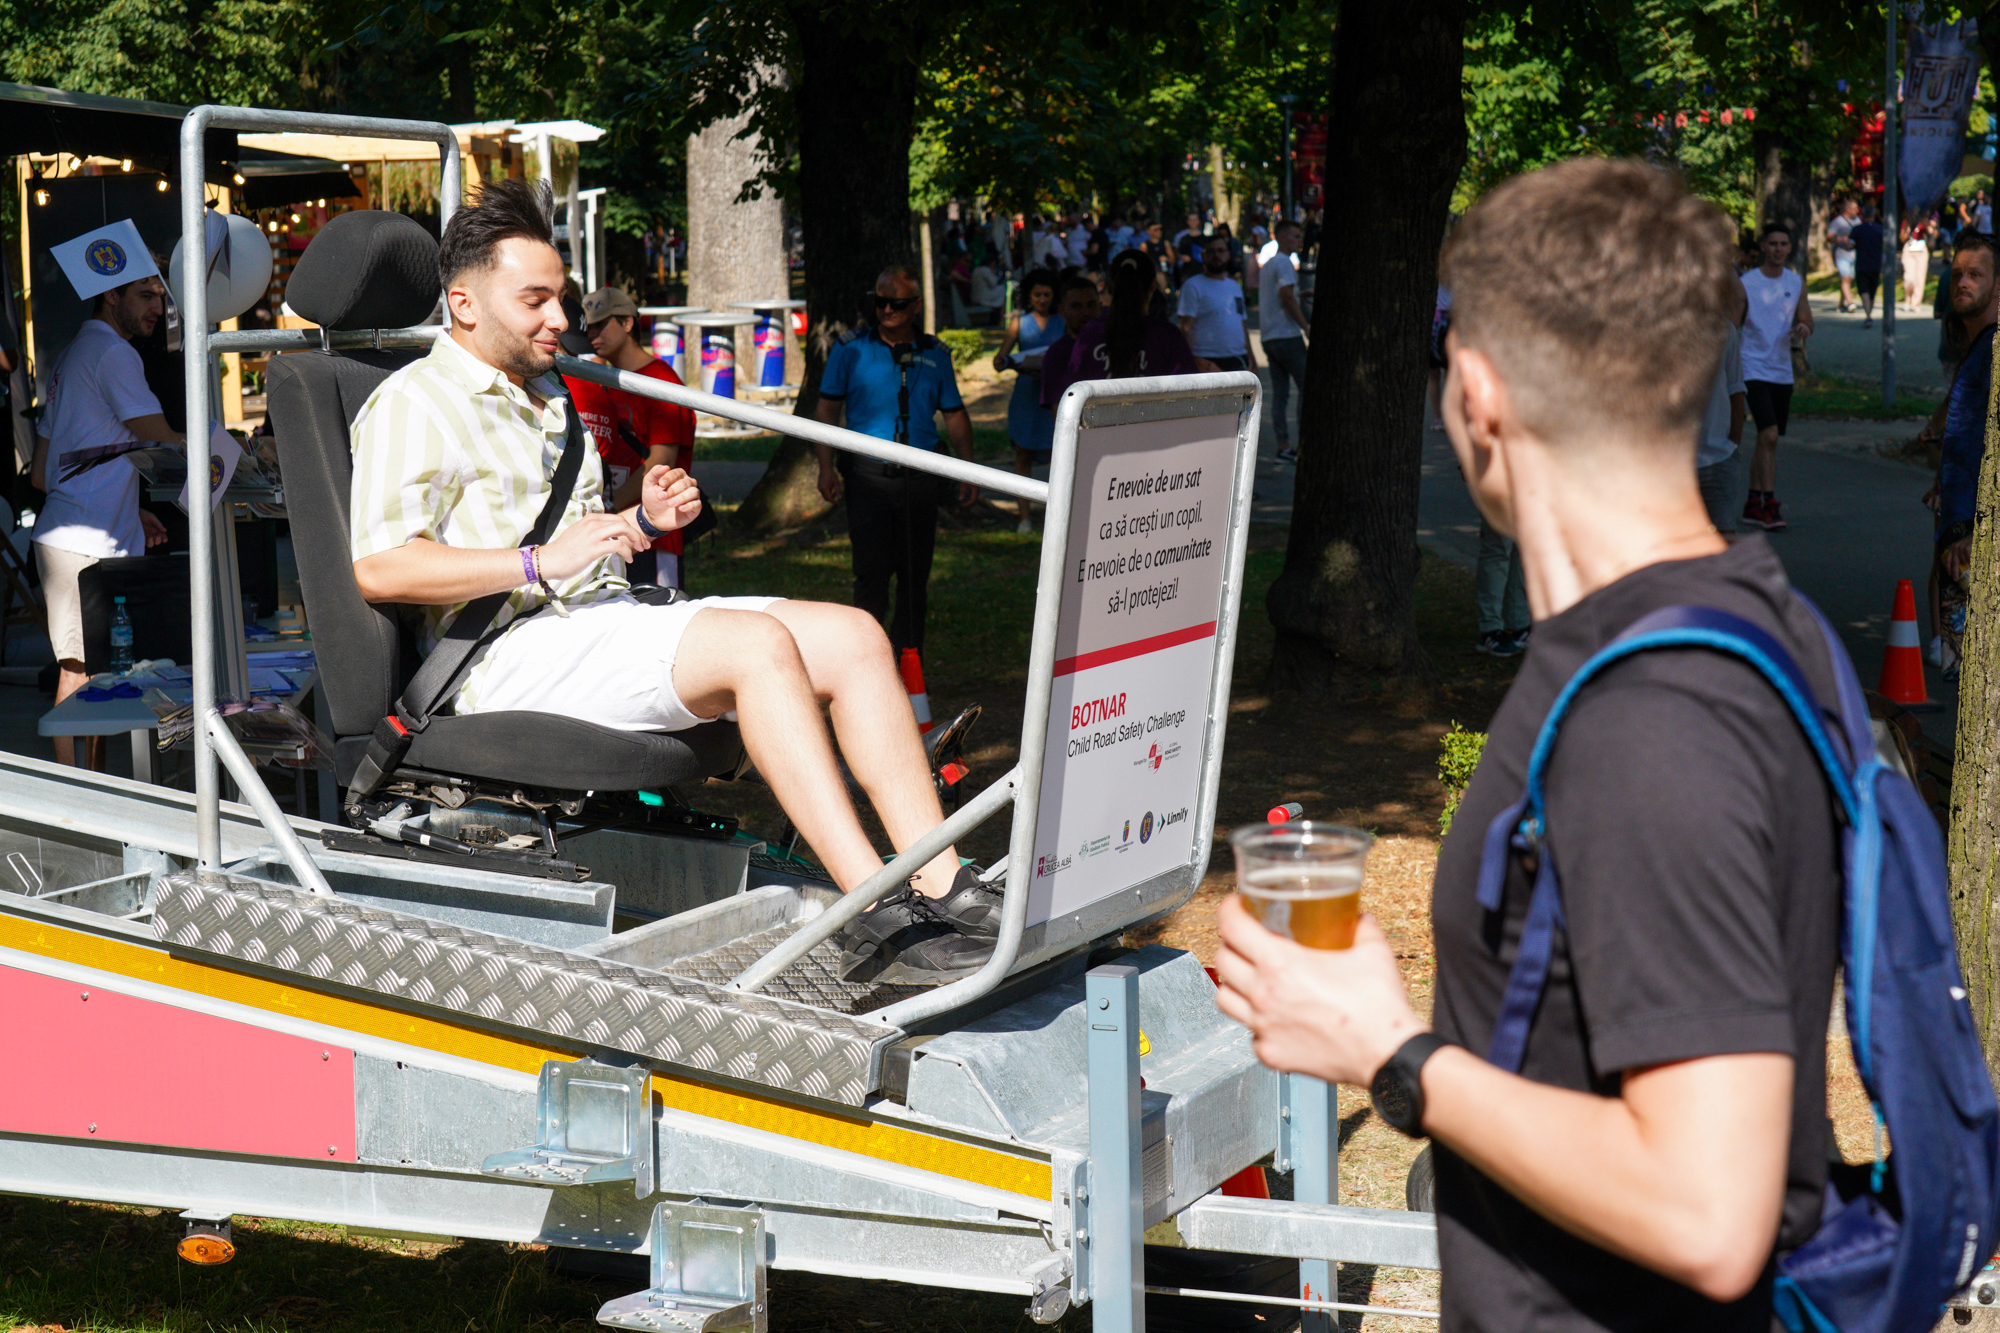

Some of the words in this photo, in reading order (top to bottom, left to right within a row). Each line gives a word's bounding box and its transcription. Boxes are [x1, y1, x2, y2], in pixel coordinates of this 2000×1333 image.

[600, 415, 609, 425] TO
[1108, 477, 1117, 501] E
[1117, 472, 1154, 499] nevoie
[1155, 469, 1168, 493] de
[1170, 472, 1184, 491] un
[1185, 467, 1202, 488] sat
[1100, 521, 1112, 540] ca
[1115, 513, 1127, 538] să
[1129, 508, 1159, 538] crești
[1161, 511, 1174, 529] un
[1176, 500, 1203, 530] copil.
[1078, 559, 1086, 583] E
[1088, 552, 1126, 580] nevoie
[1128, 548, 1143, 573] de
[1145, 551, 1152, 569] o
[1154, 538, 1212, 567] comunitate
[1107, 587, 1128, 614] să-l
[1129, 577, 1179, 615] protejezi!
[1071, 692, 1127, 730] BOTNAR
[1068, 735, 1091, 758] Child
[1093, 727, 1117, 750] Road
[1118, 721, 1145, 742] Safety
[1146, 709, 1186, 733] Challenge
[1166, 807, 1189, 826] Linnify
